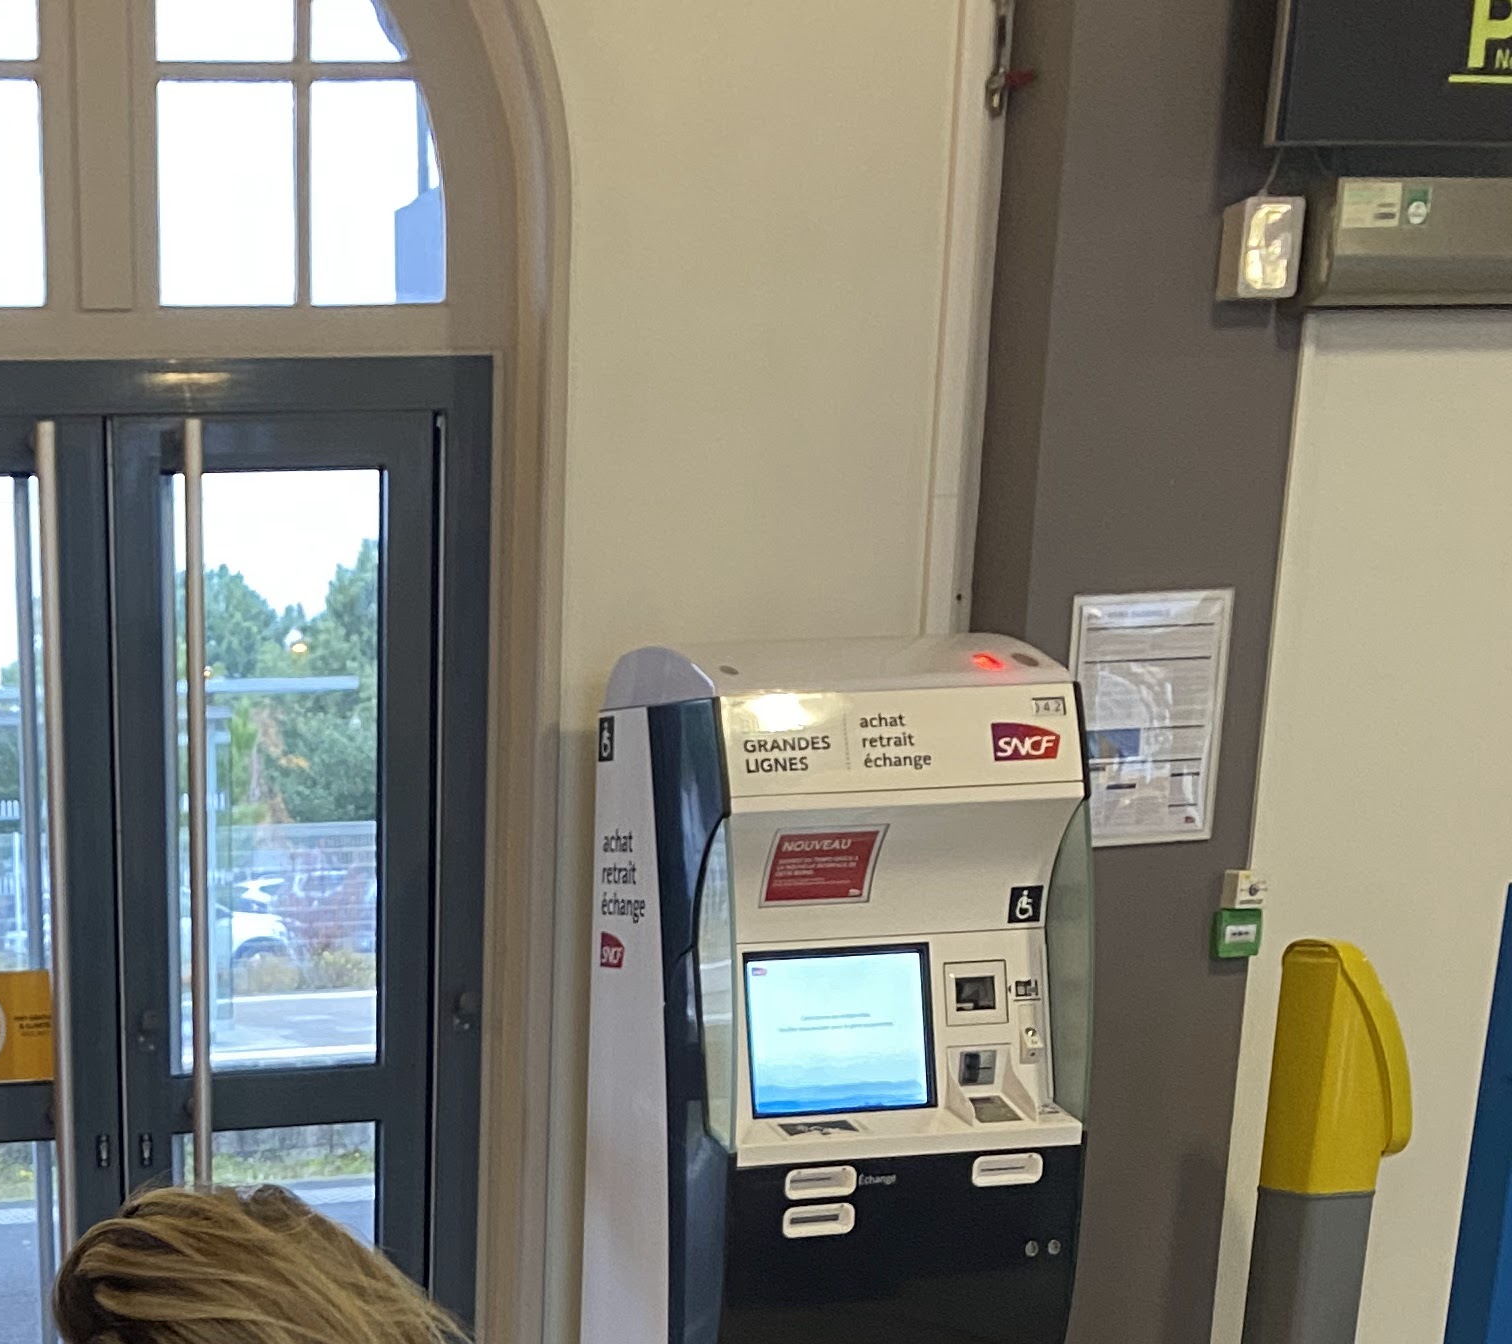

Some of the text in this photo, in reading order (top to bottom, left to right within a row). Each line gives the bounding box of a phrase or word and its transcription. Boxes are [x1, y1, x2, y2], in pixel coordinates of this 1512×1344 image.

[859, 713, 906, 728] achat
[743, 736, 831, 753] GRANDES
[862, 733, 915, 748] retrait
[996, 736, 1056, 757] SNCF
[746, 756, 809, 773] LIGNES
[863, 753, 932, 770] échange
[603, 829, 633, 853] achat
[781, 839, 852, 852] NOUVEAU
[601, 861, 637, 885] retrait
[601, 892, 646, 924] échange
